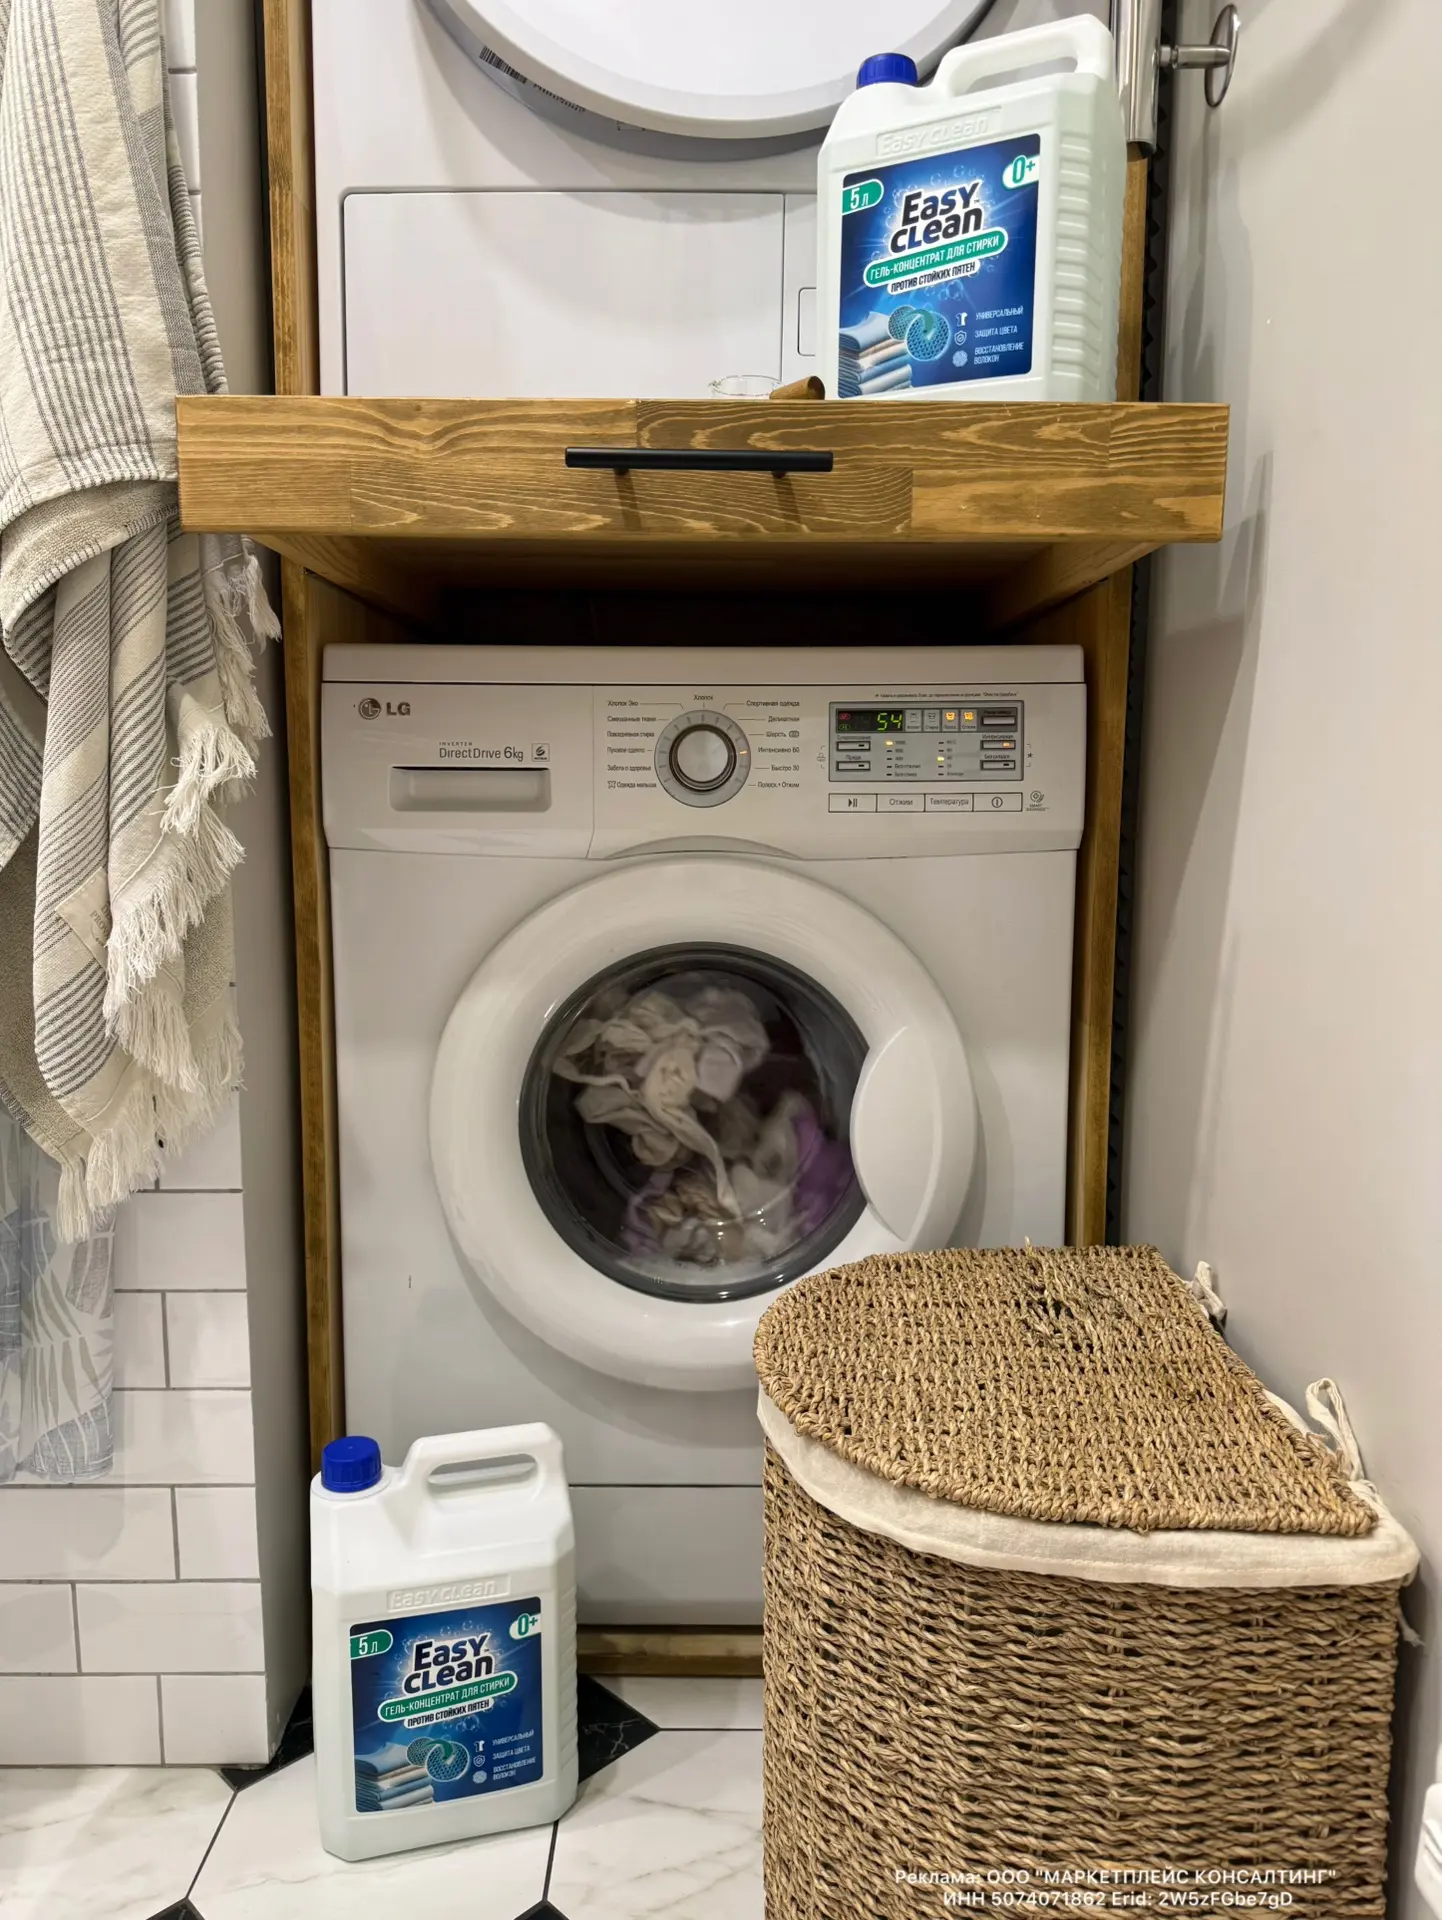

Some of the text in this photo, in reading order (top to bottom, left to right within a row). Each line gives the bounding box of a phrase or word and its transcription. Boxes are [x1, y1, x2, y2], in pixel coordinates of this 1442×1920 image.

[1013, 157, 1036, 183] 0+
[850, 187, 870, 209] 5 л
[870, 235, 1000, 280] ГЕЛЬ-КОНЦЕНТРАТ ДЛЯ СТИРКИ
[891, 261, 976, 293] ПРОТИВ СТОЙКИХ ПЯТЕН
[975, 305, 1024, 321] УНИВЕРСАЛЬНЫЙ
[974, 325, 1018, 339] ЗАЩИТА ЦВЕТА
[974, 341, 1025, 356] ВОССТАНОВЛЕНИЕ
[973, 354, 1000, 365] ВОЛОКОН
[386, 702, 411, 716] LG
[877, 712, 903, 731] 54
[504, 746, 524, 762] 6kg
[889, 798, 913, 806] Отжим
[930, 798, 970, 807] Температура
[518, 1615, 539, 1636] 0+
[358, 1637, 378, 1654] 5 л
[385, 1678, 511, 1716] ГЕЛЬ-КОНЦЕНТРАТ ДЛЯ СТИРКИ
[407, 1700, 490, 1728] ПРОТИВ СТОЙКИХ ПЯТЕН
[492, 1750, 514, 1761] ЗАЩИТА
